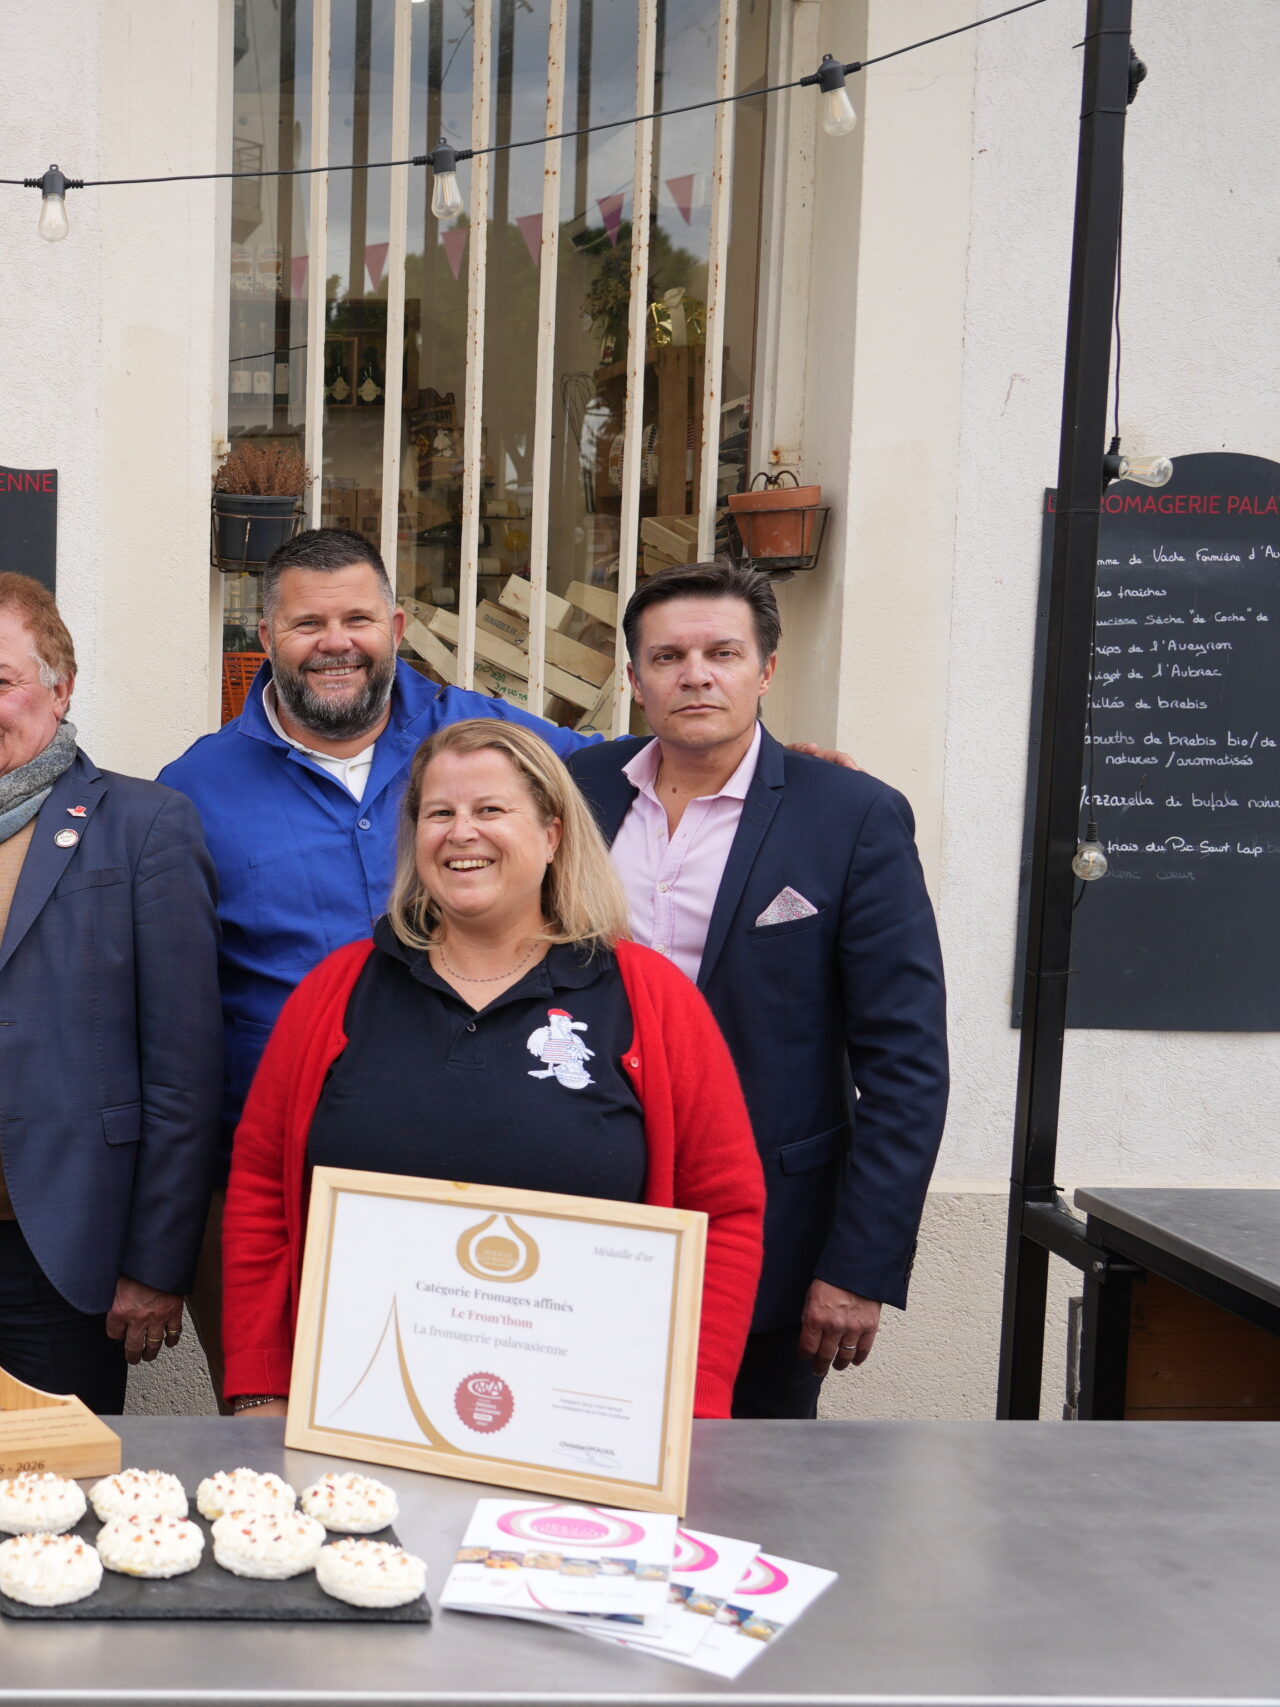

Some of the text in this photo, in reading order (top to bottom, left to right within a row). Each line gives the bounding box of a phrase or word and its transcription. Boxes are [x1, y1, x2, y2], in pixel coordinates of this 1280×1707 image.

[1099, 495, 1221, 514] OMAGERIE
[1227, 496, 1280, 515] PALA
[1128, 554, 1143, 566] de
[1153, 545, 1186, 562] Vache
[1096, 617, 1138, 626] ucisse
[1128, 644, 1144, 653] de
[1127, 668, 1144, 679] de
[1135, 698, 1151, 709] de
[1157, 695, 1208, 709] brebis
[1084, 723, 1135, 745] aourths
[1143, 732, 1162, 745] de
[1168, 732, 1217, 746] brebis
[1105, 753, 1158, 765] natures
[1107, 840, 1138, 854] frais
[592, 1246, 654, 1263] Médaille d'or
[416, 1280, 574, 1313] Catégorie Fromages affinés
[451, 1307, 465, 1319] Le
[413, 1322, 568, 1357] La fromagerie palavasienne
[15, 1460, 45, 1474] 2026
